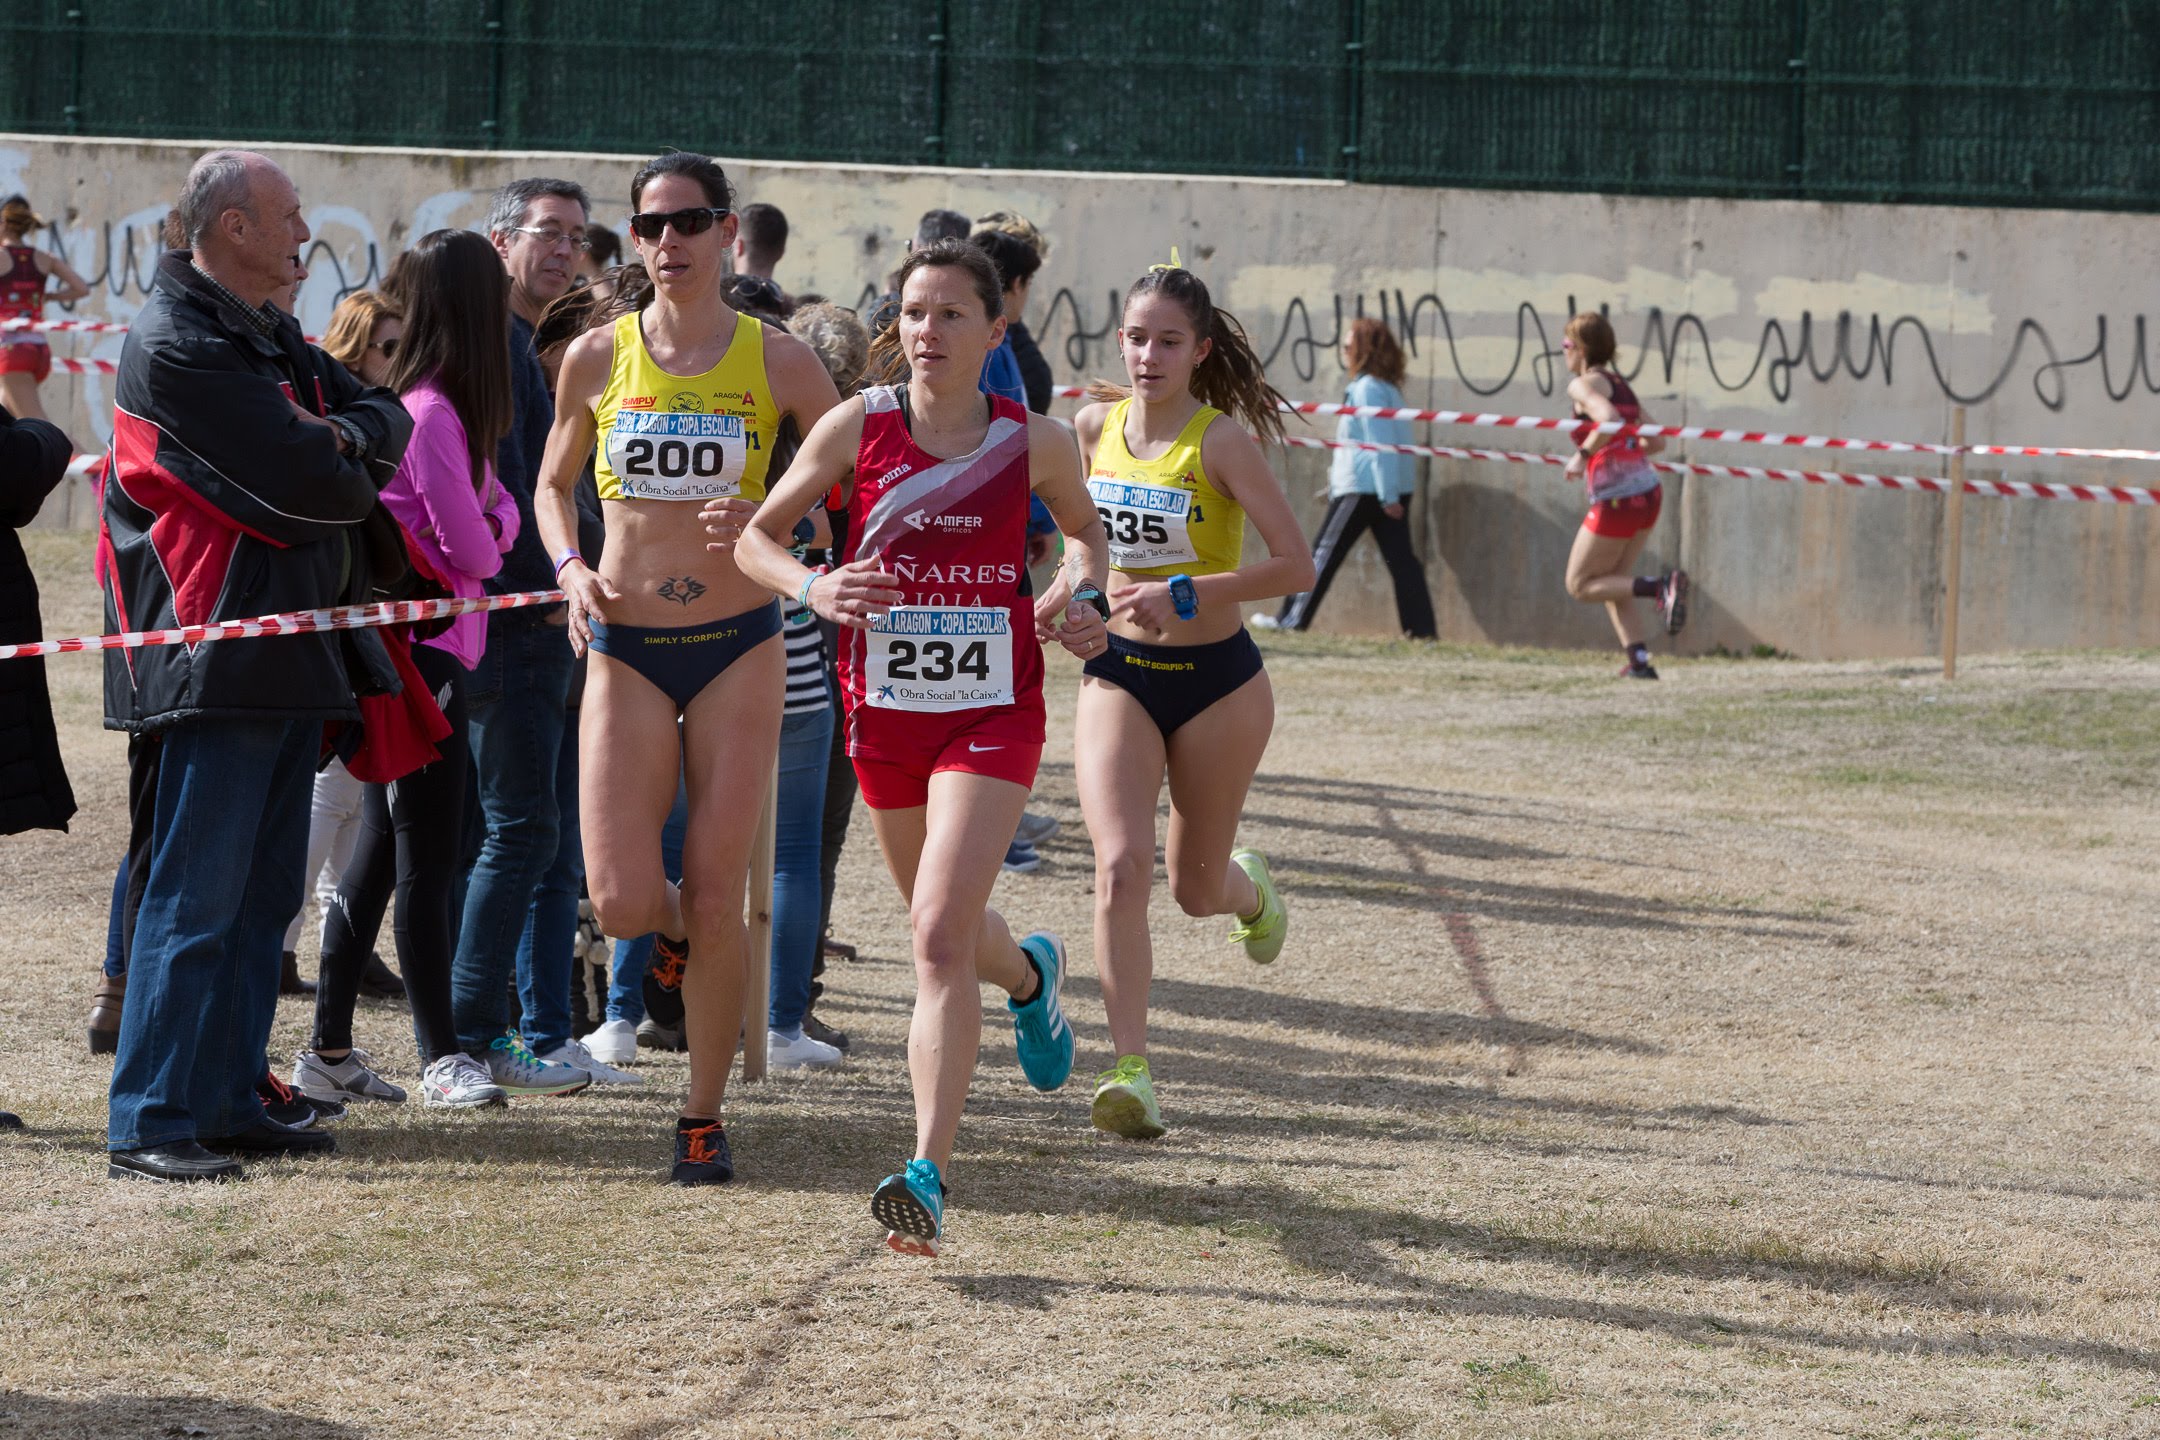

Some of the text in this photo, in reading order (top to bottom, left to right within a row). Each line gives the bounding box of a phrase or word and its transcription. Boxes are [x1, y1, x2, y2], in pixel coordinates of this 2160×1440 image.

[713, 391, 743, 399] ARAGÓN
[726, 408, 757, 418] Zaragoza
[614, 412, 635, 433] COPA
[635, 413, 669, 434] ARAGON
[677, 415, 699, 435] COPA
[701, 416, 740, 438] ESCOLAR
[625, 438, 724, 478] 200
[640, 482, 661, 495] Obra
[663, 485, 691, 496] Social
[1130, 487, 1149, 508] COPA
[1149, 490, 1184, 513] ESCOLAR
[933, 515, 983, 528] AMFER
[943, 526, 972, 534] ÓPTICOS
[1122, 549, 1147, 559] Social
[894, 612, 932, 634] ARAGON
[940, 613, 964, 634] COPA
[966, 613, 1006, 635] ESCOLAR
[643, 629, 738, 645] SIMPLY SCORPIO-71
[887, 640, 990, 682] 234
[1151, 661, 1195, 671] SCORPIO-71
[900, 687, 924, 700] Obra
[926, 689, 956, 701] Social
